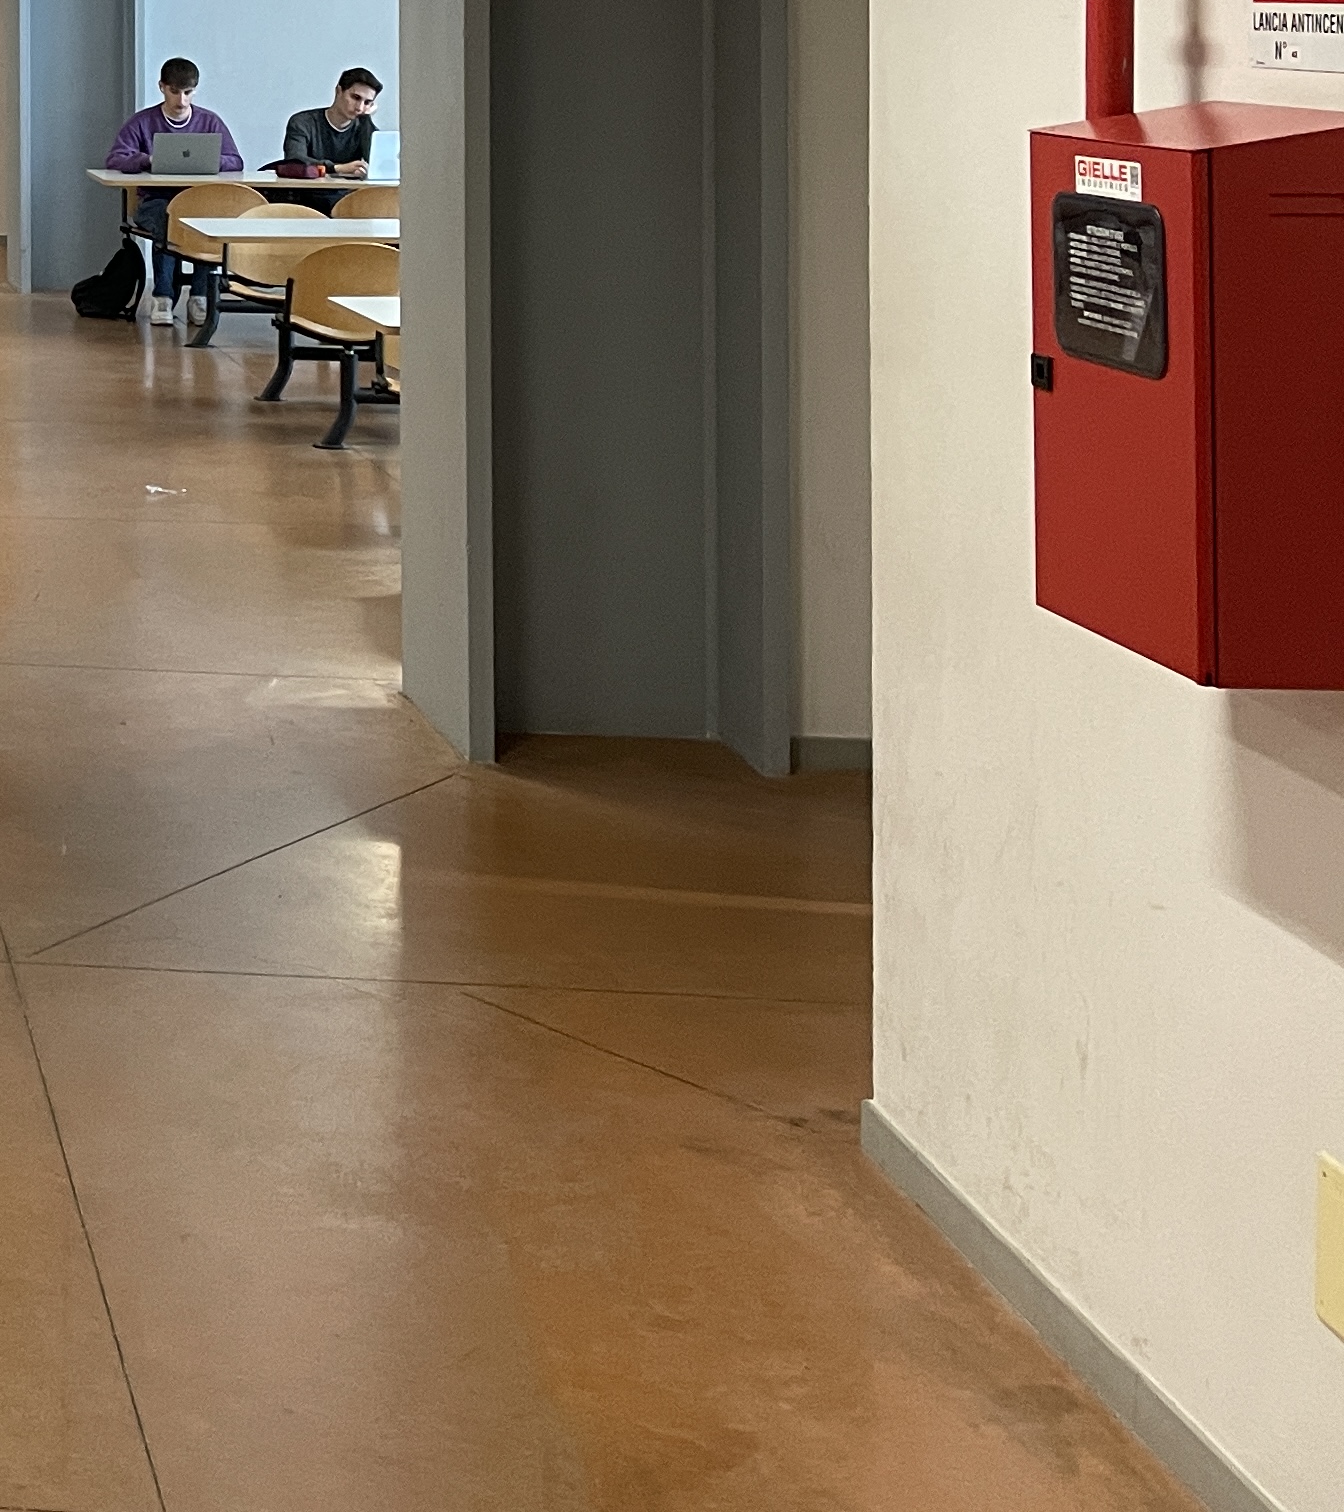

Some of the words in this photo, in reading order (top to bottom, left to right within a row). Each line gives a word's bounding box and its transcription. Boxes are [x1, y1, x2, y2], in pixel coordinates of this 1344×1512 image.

[1253, 12, 1288, 32] LANCIA
[1078, 160, 1128, 182] GIELLE
[1078, 178, 1128, 193] INDUSTRIES
